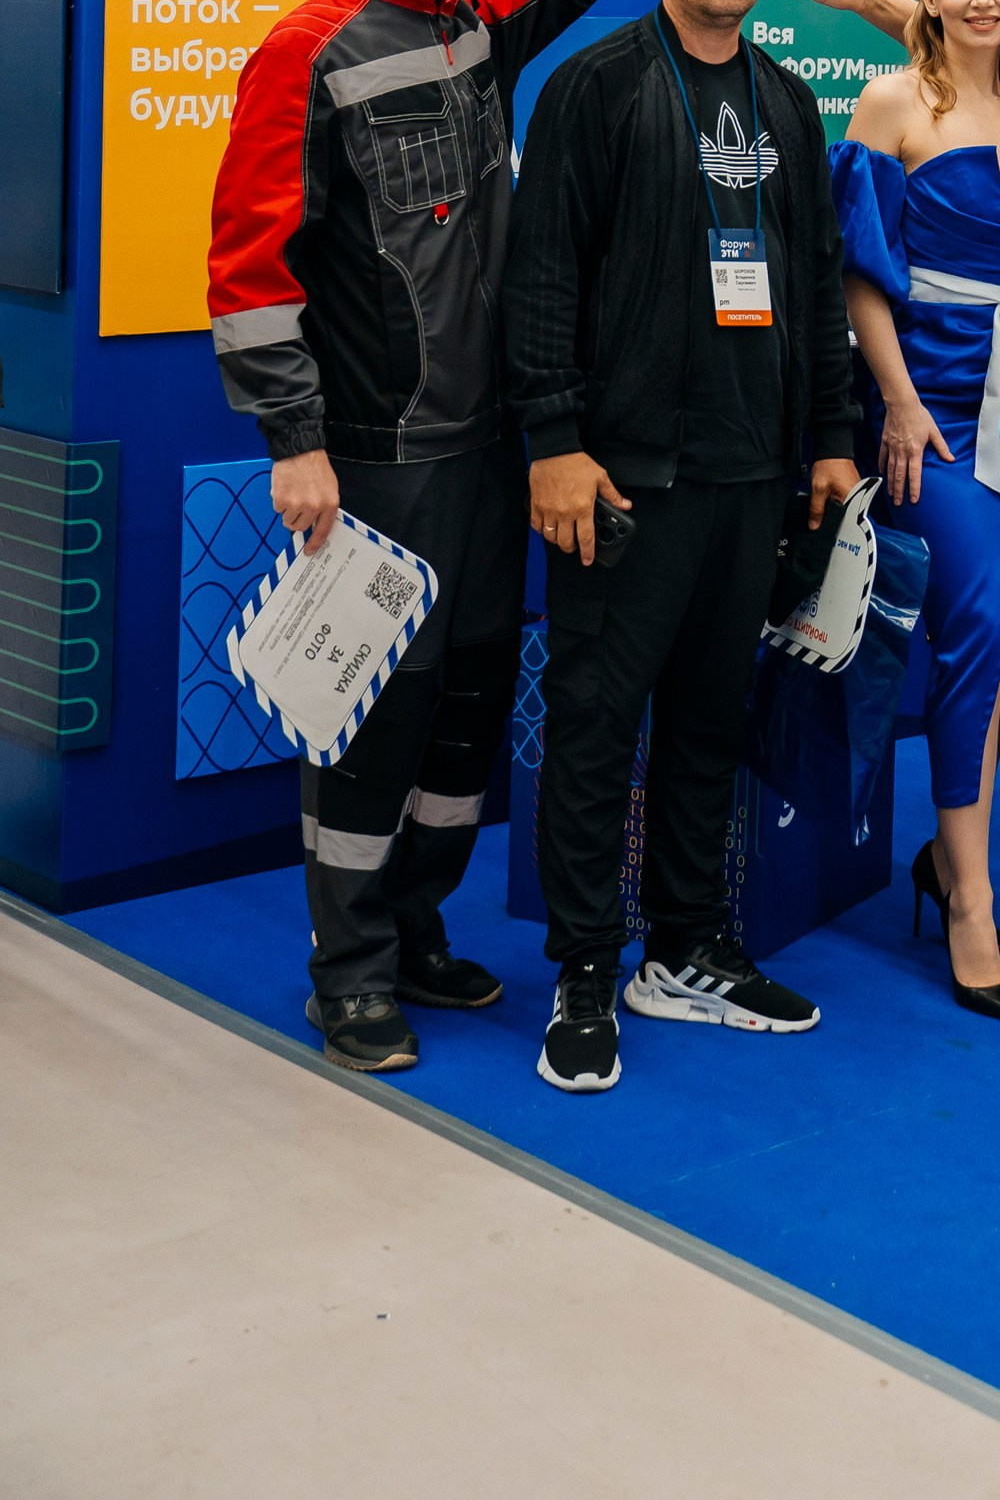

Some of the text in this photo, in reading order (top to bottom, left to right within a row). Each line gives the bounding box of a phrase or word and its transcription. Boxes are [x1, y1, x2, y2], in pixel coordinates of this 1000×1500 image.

[752, 21, 795, 45] Вся
[131, 39, 261, 80] выбра
[720, 239, 750, 250] Форум
[721, 249, 739, 258] ЭТМ
[304, 622, 332, 661] ФОТО
[326, 645, 345, 664] ЗА
[333, 643, 372, 694] СКИДКА
